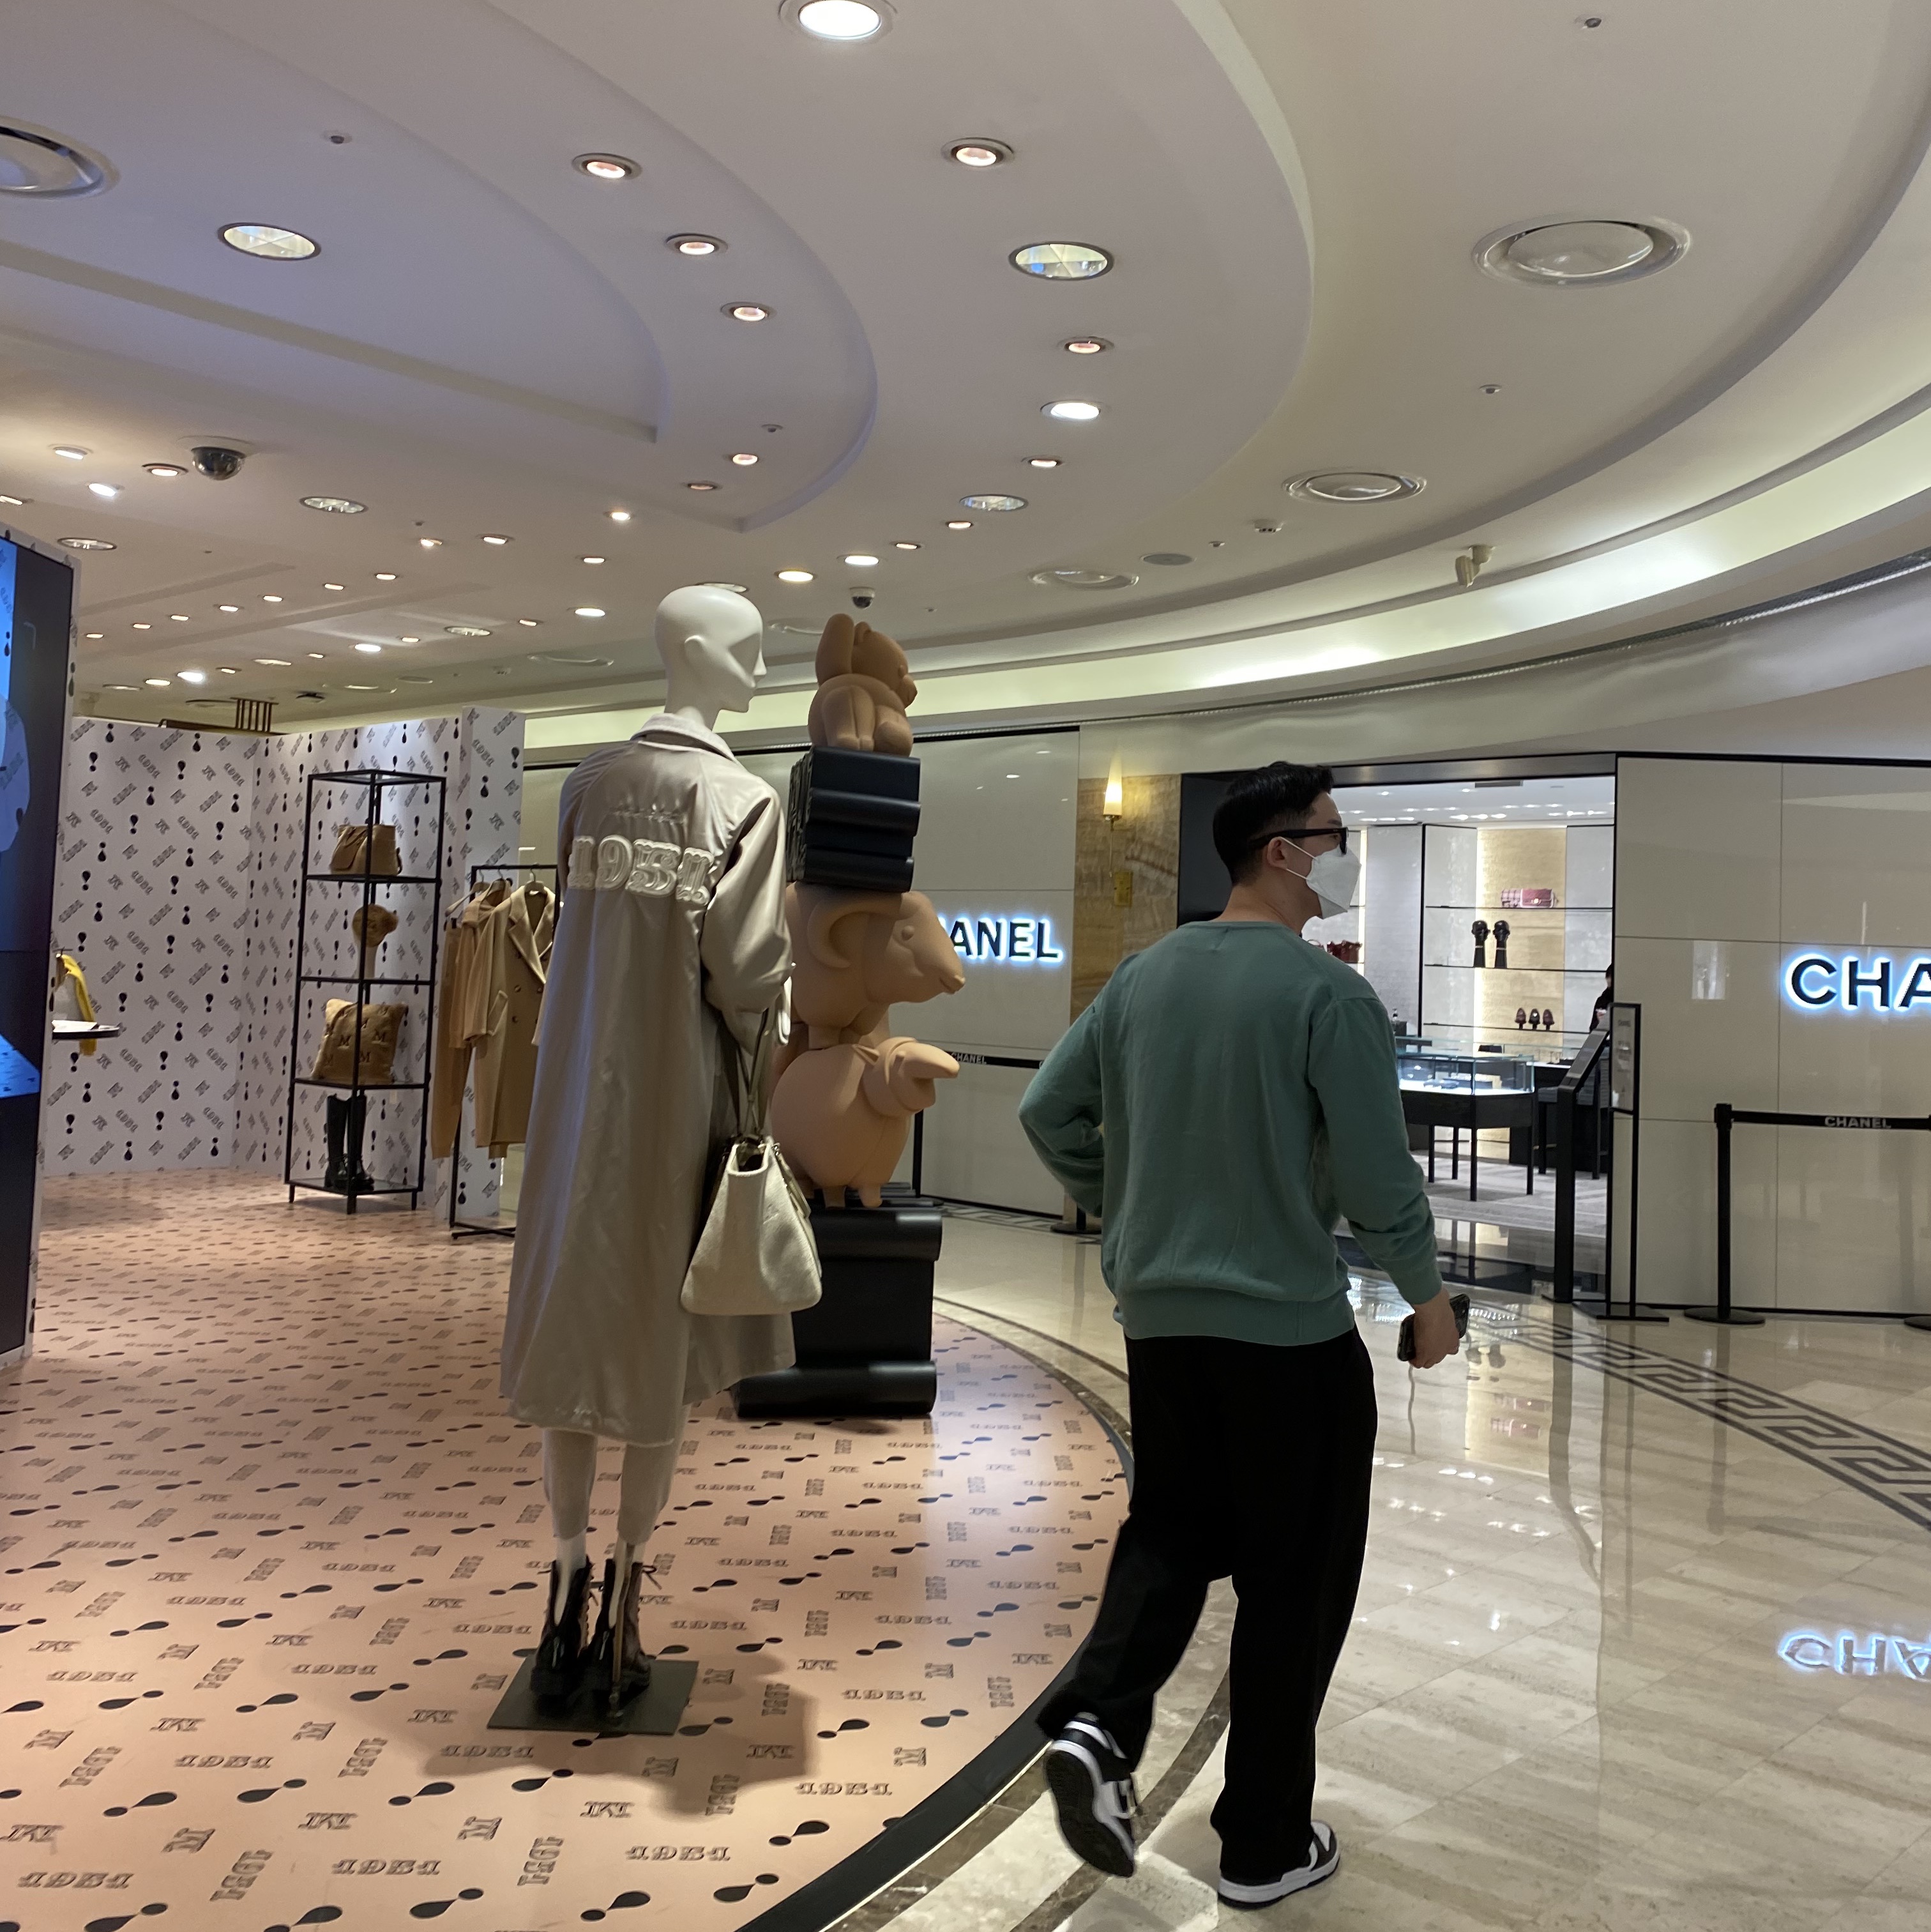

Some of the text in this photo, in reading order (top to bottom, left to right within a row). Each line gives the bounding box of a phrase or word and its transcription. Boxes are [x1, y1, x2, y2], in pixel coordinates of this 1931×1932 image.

[567, 834, 715, 906] 1951
[948, 920, 1059, 959] ANEL
[1824, 1116, 1891, 1129] CHANEL
